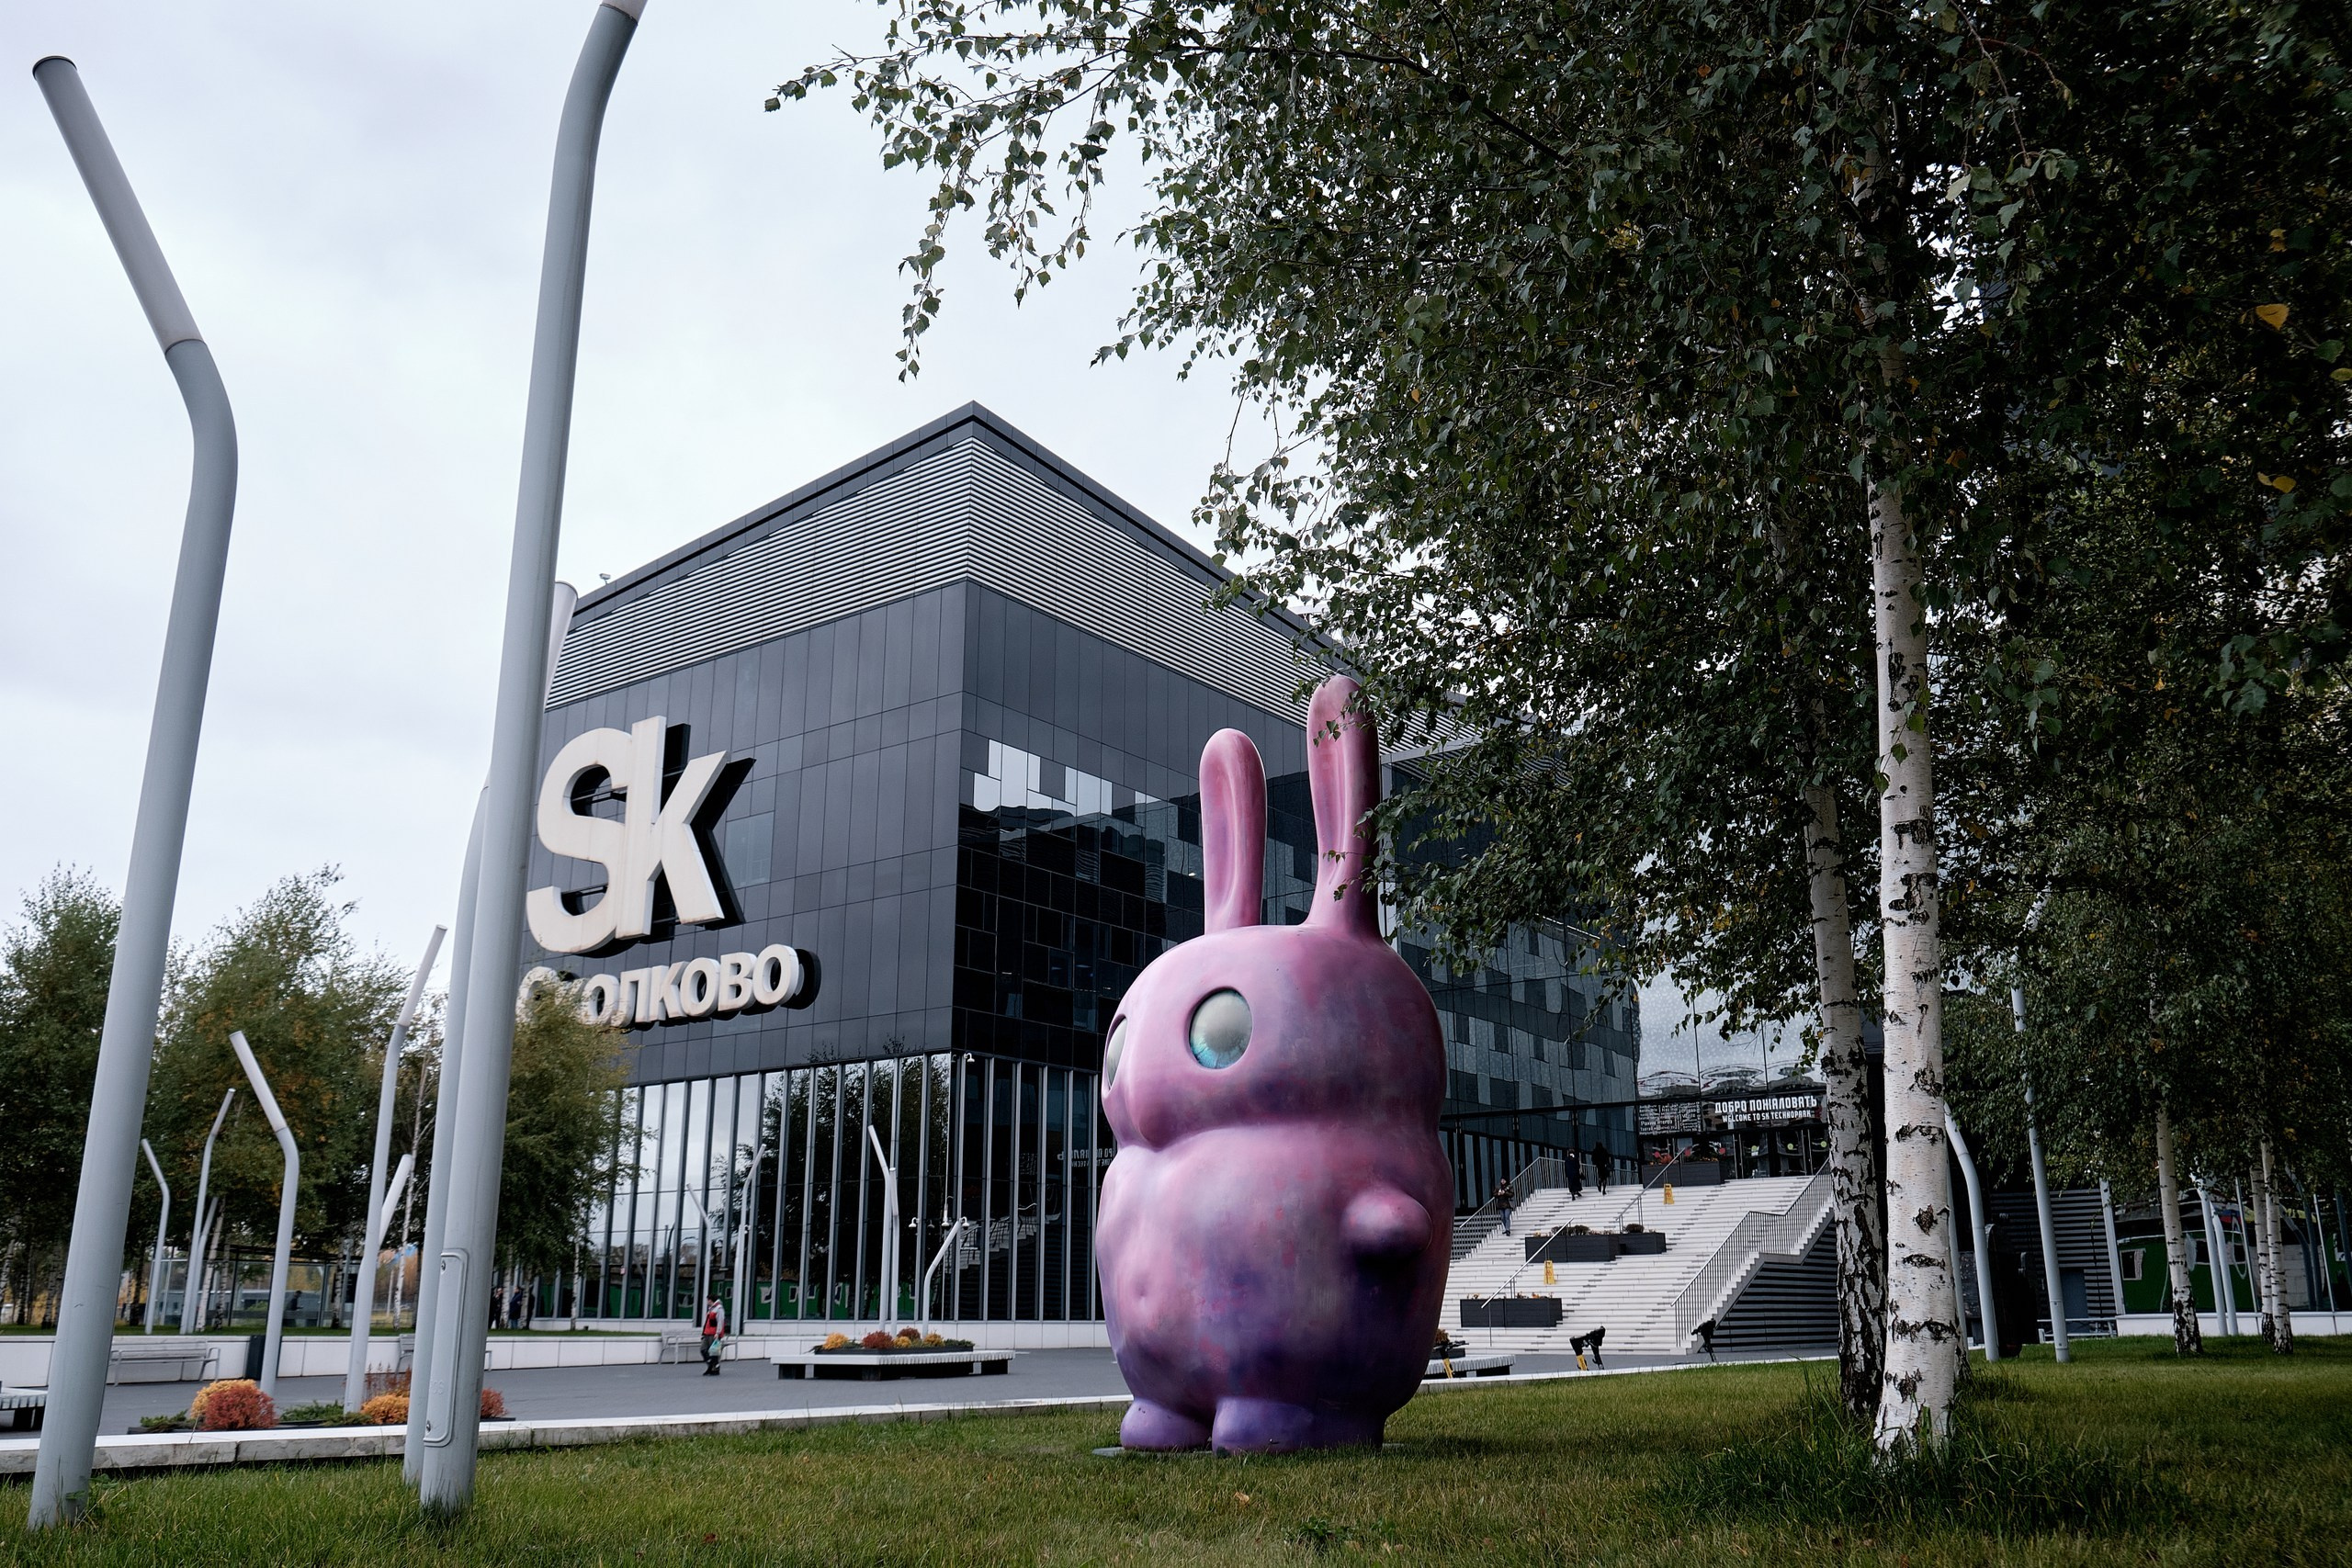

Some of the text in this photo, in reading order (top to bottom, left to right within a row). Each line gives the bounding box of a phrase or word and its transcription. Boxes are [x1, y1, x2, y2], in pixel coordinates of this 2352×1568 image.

[1714, 1095, 1817, 1113] ДОБРО ПОЖАЛОВАТЬ
[1722, 1114, 1751, 1122] WELCOME
[1753, 1112, 1761, 1121] TO
[1770, 1110, 1812, 1120] TECHNOPARK
